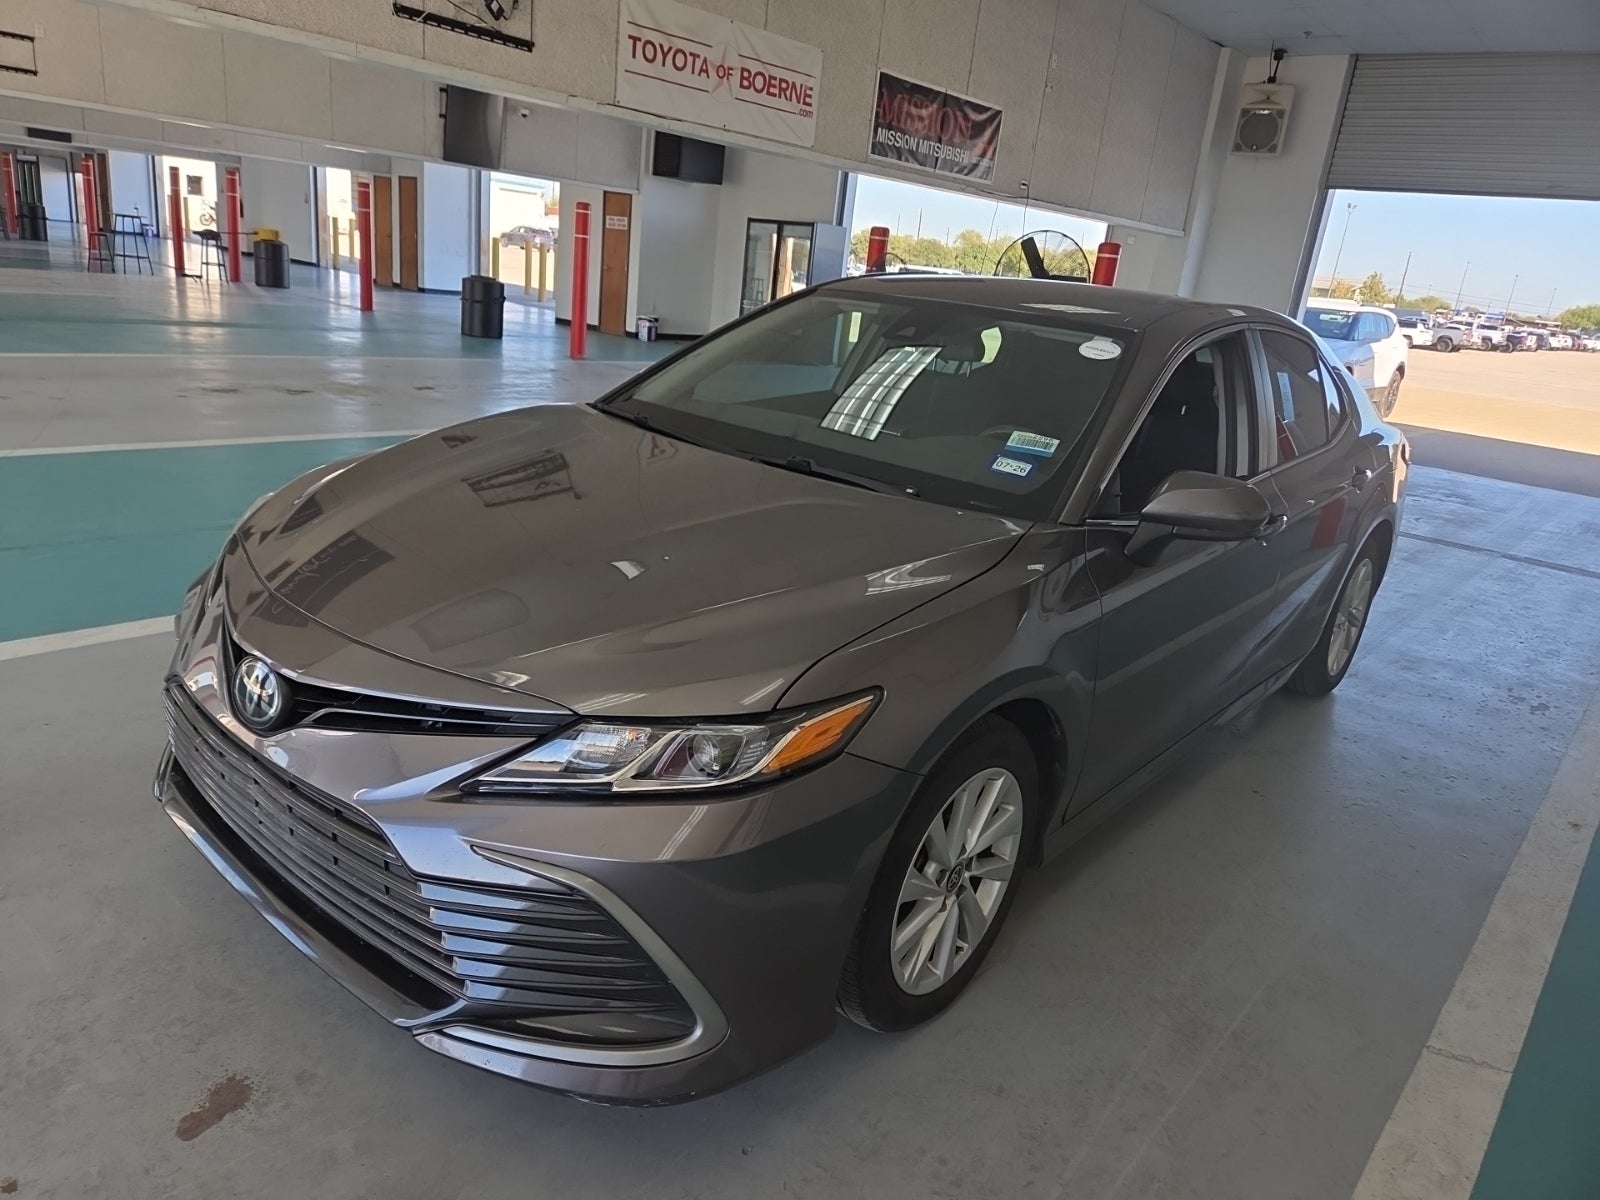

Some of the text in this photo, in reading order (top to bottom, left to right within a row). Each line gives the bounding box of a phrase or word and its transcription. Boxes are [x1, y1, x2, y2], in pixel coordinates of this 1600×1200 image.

[627, 34, 814, 108] TOYOTA OF BOERNE
[876, 127, 970, 164] MISSION MITSUBISHI
